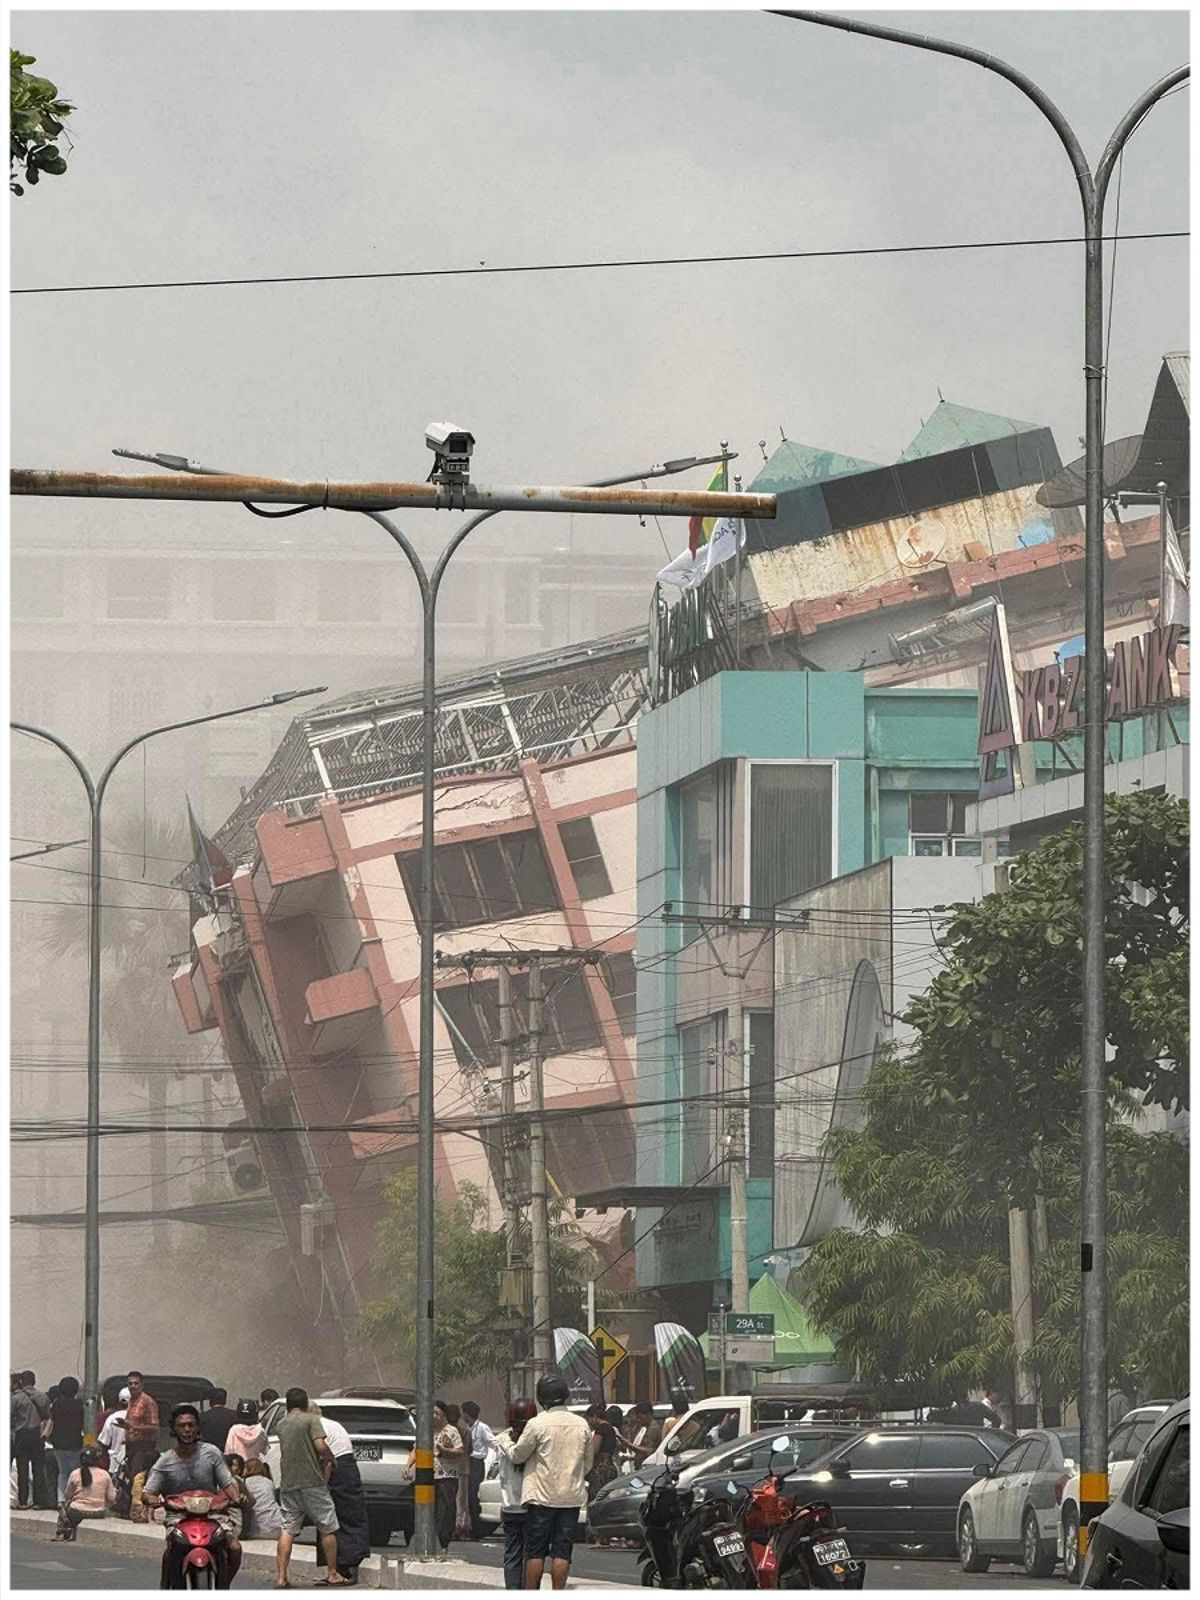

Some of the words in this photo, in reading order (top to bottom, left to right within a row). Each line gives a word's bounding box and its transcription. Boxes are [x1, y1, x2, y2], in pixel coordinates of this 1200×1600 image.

[1022, 655, 1085, 742] KBZ
[1106, 623, 1182, 723] ANK
[735, 1318, 755, 1329] 29A
